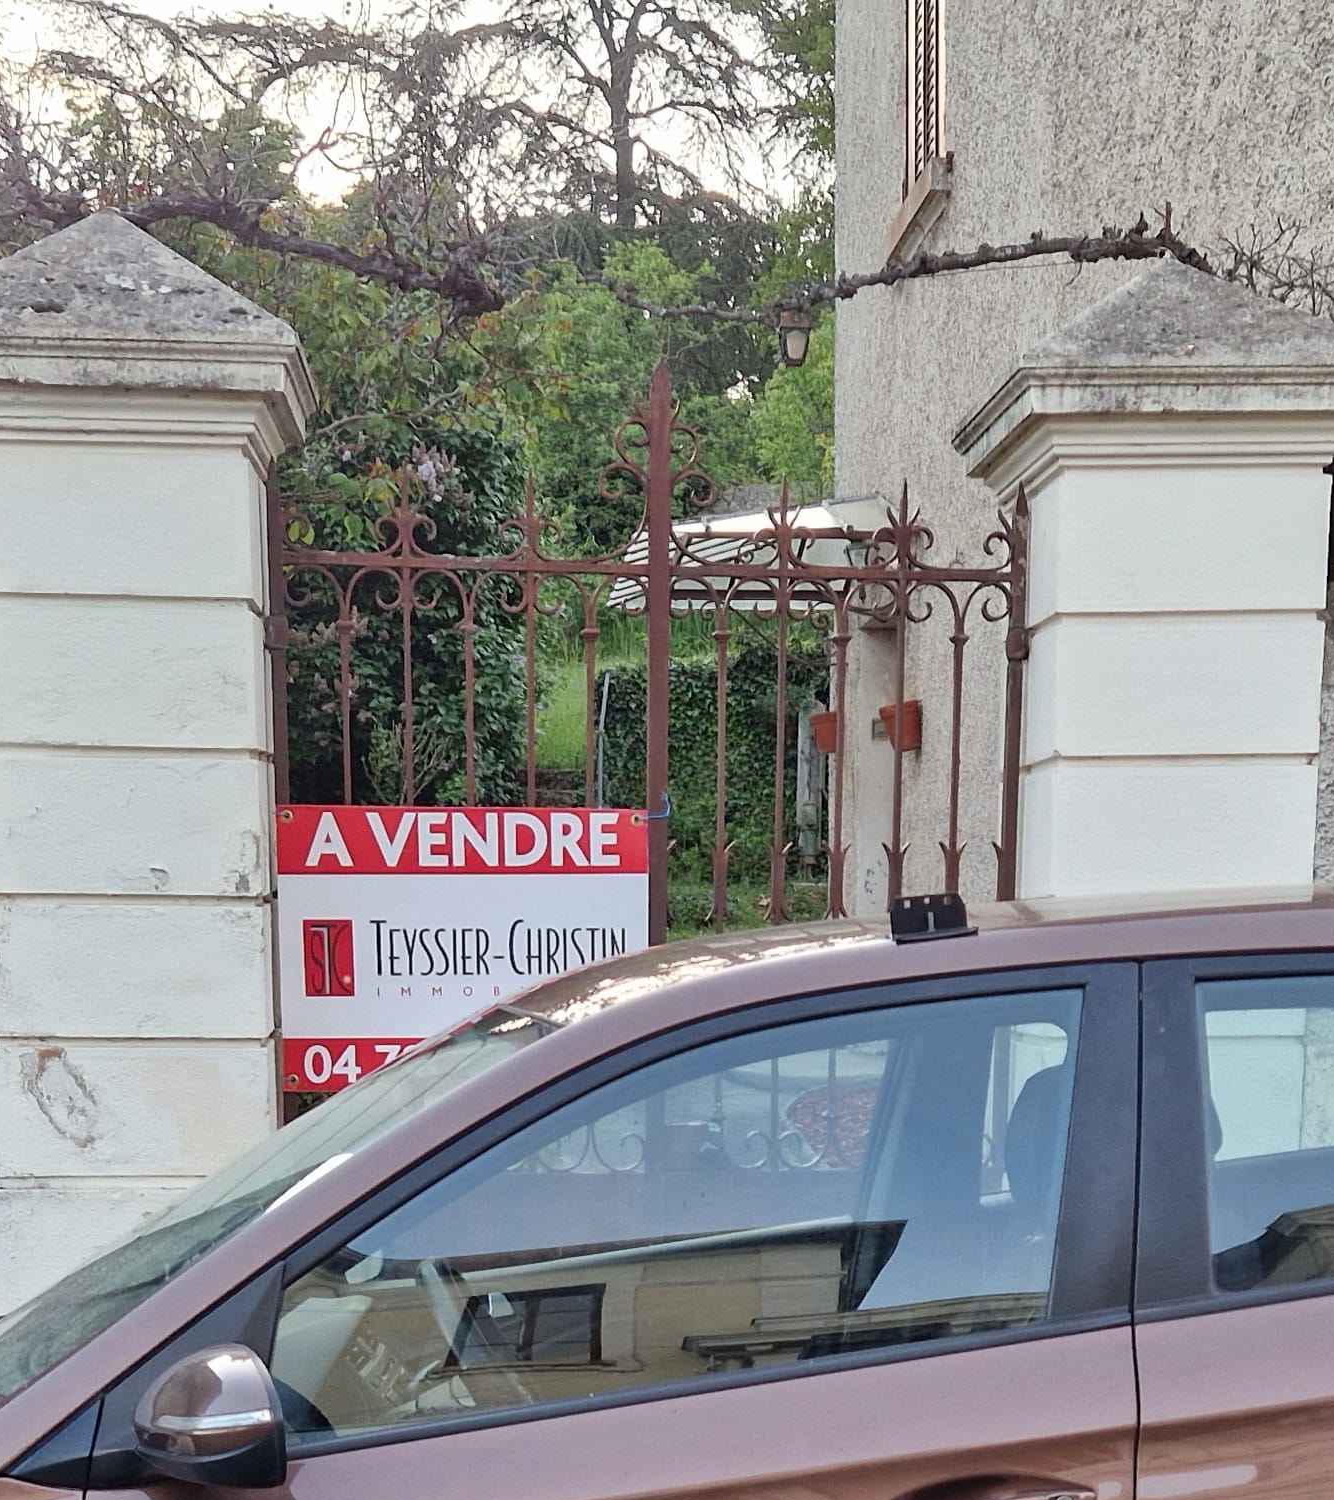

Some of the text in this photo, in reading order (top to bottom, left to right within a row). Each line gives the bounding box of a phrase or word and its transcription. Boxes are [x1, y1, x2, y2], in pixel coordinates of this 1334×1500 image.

[305, 811, 621, 867] A VENDRE
[377, 986, 524, 998] IMMOB
[304, 1045, 361, 1084] 04
